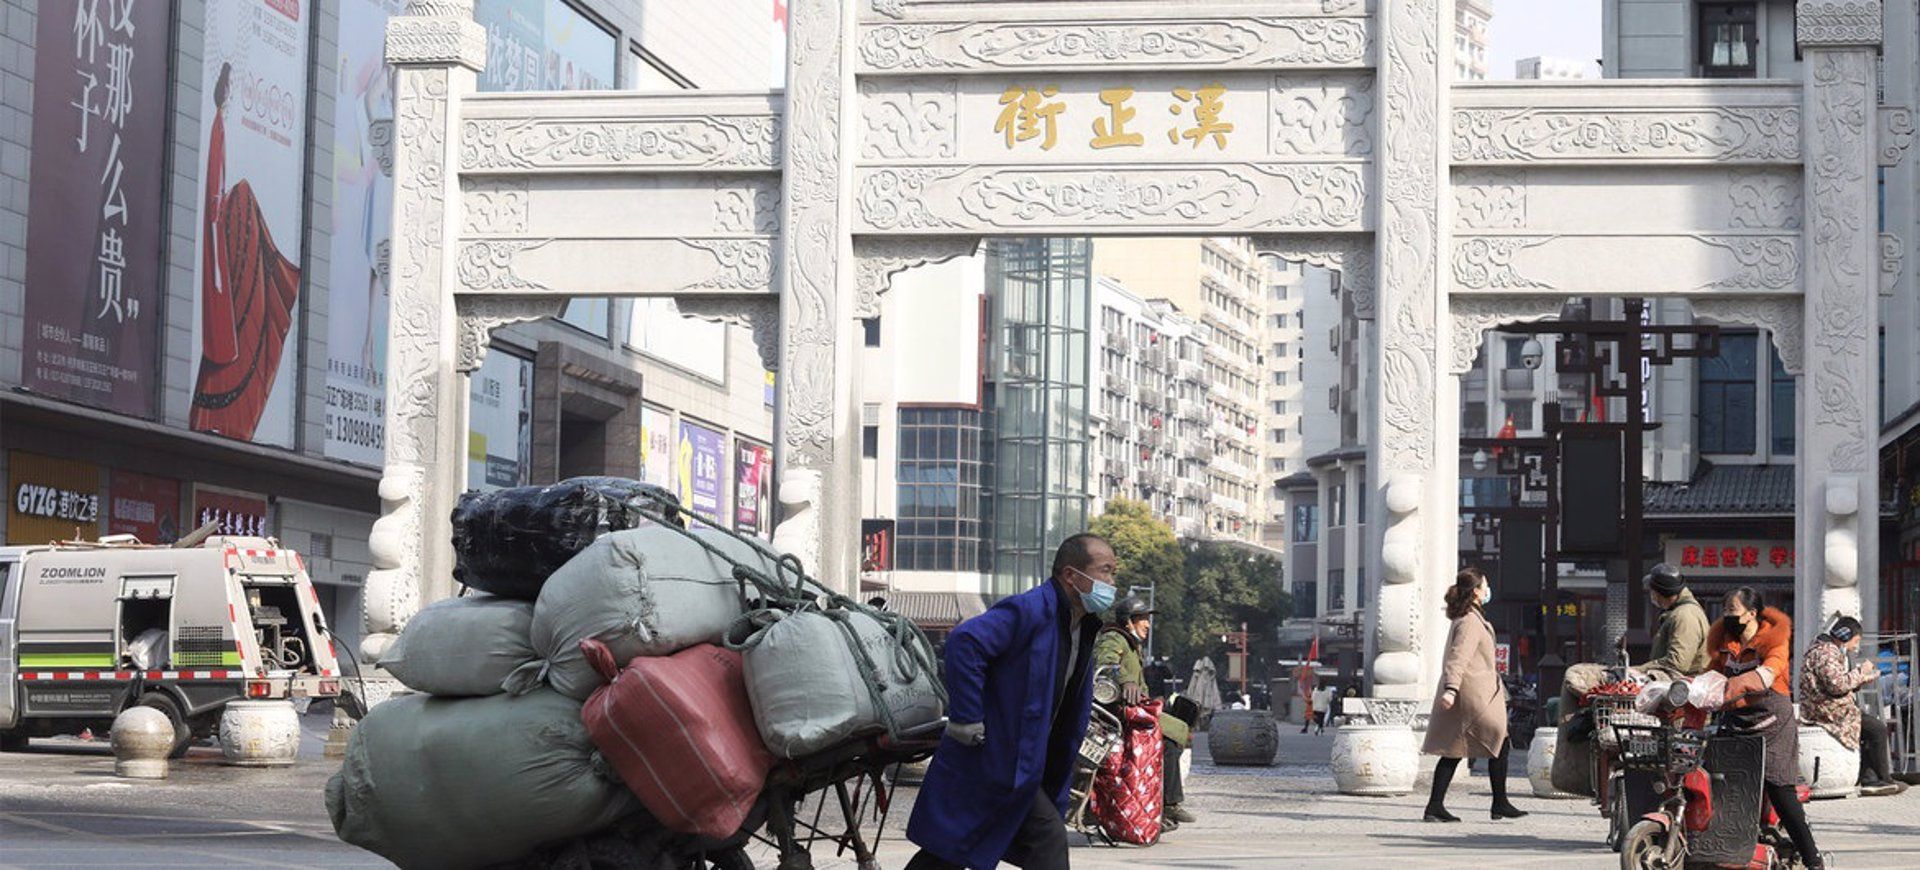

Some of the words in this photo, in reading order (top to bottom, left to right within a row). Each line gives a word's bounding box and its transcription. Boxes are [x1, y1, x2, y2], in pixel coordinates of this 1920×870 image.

[995, 82, 1235, 151] 漢正街
[17, 483, 57, 517] GYZG
[1681, 545, 1759, 568] 床品世家
[1769, 545, 1796, 568] 学
[40, 567, 106, 578] ZOOMLION
